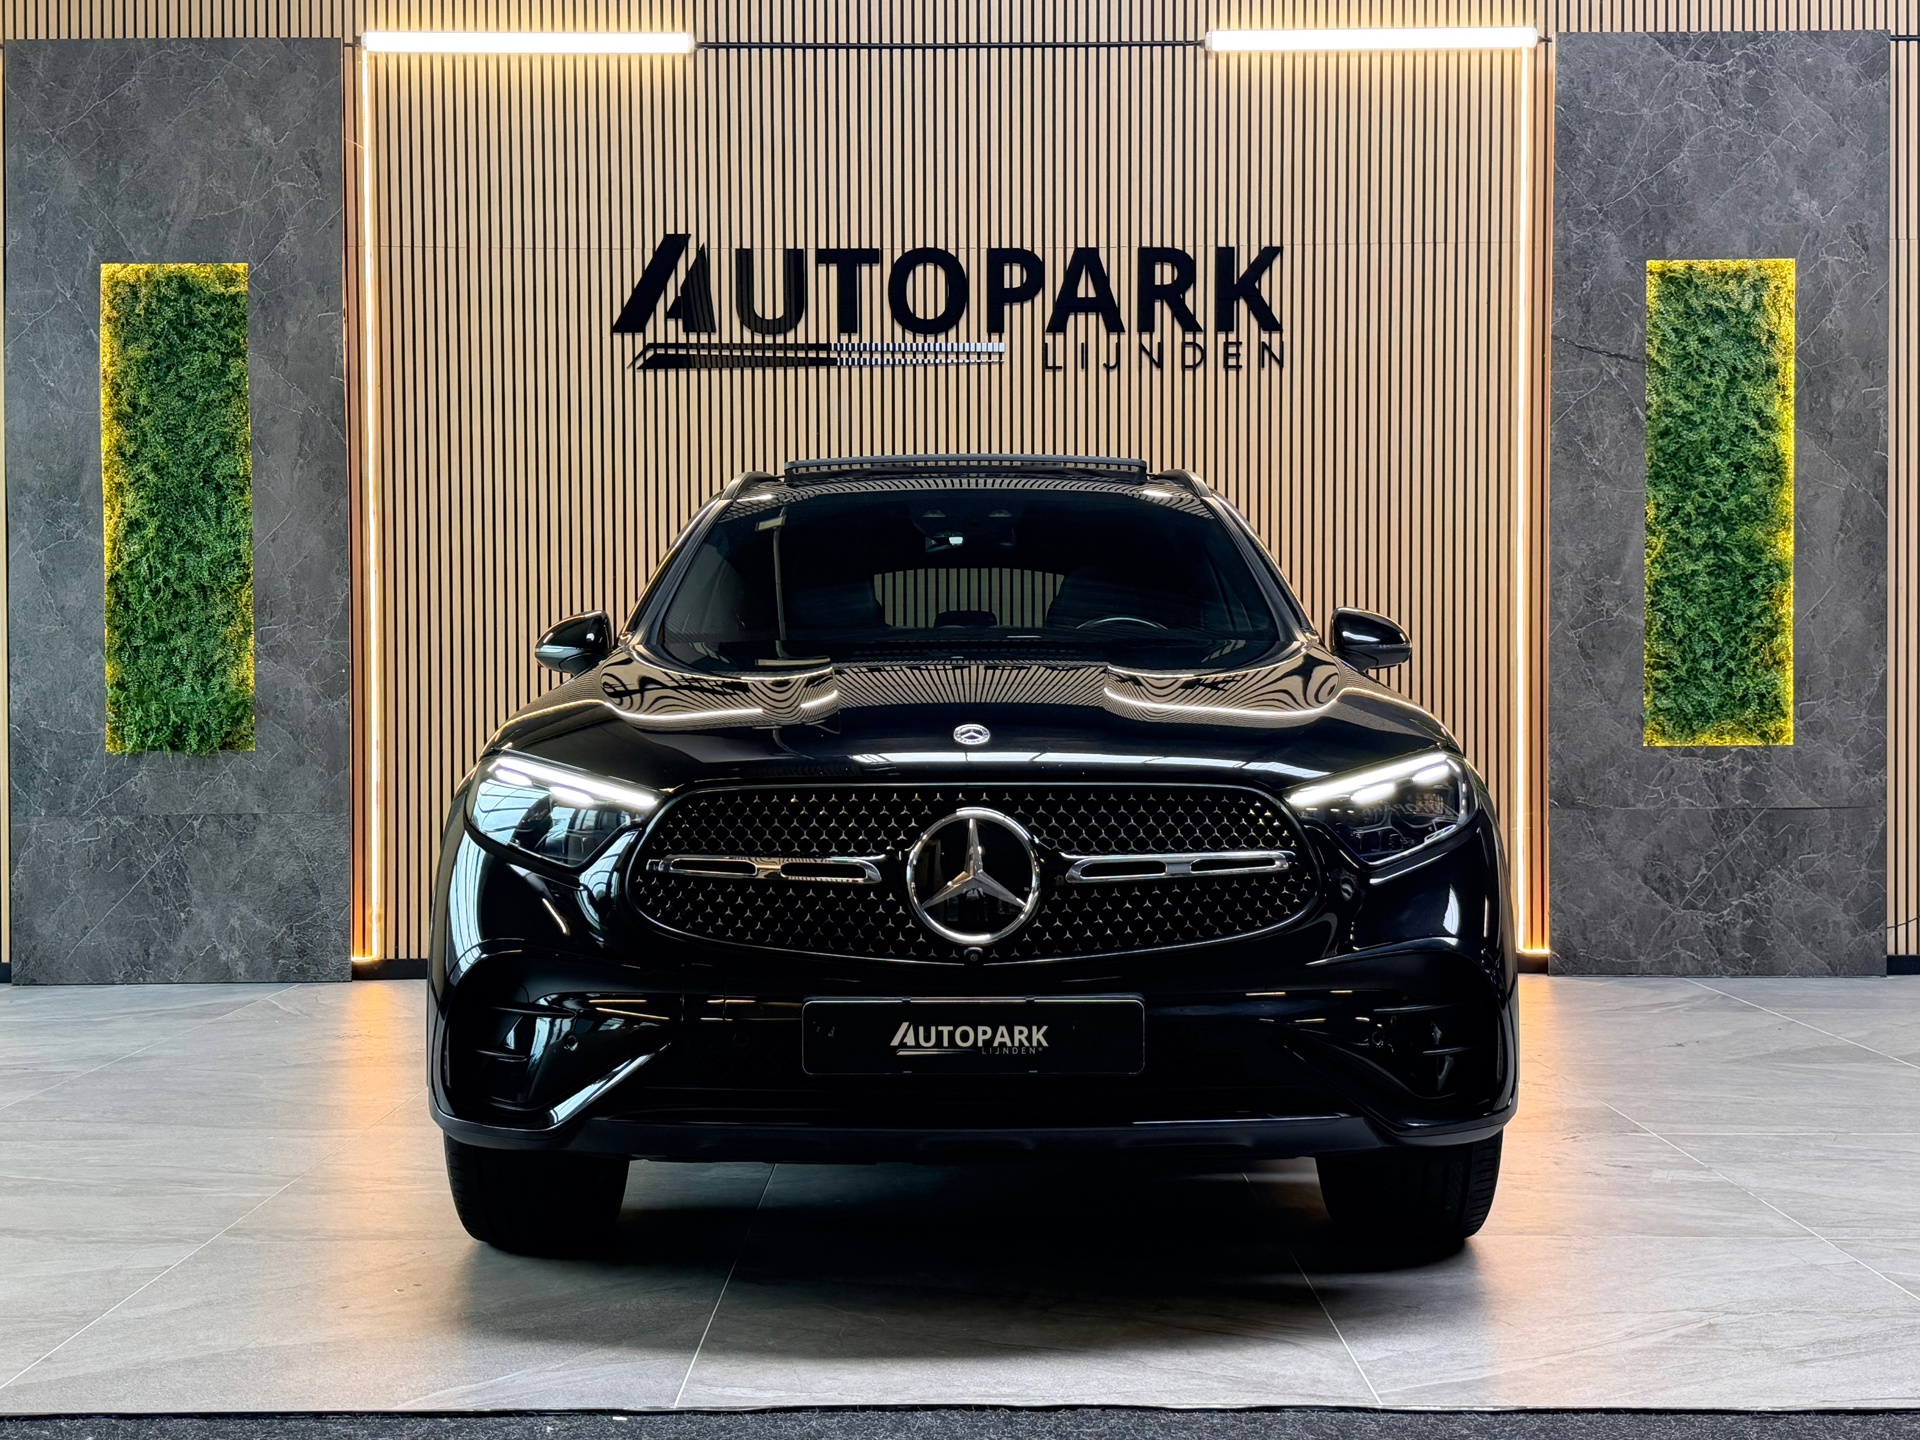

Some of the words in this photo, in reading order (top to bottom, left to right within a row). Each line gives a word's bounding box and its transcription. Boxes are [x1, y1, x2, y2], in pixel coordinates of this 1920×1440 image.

[611, 232, 1284, 335] AUTOPARK
[1043, 341, 1285, 371] LIJNDEN
[890, 1021, 1049, 1047] AUTOPARK
